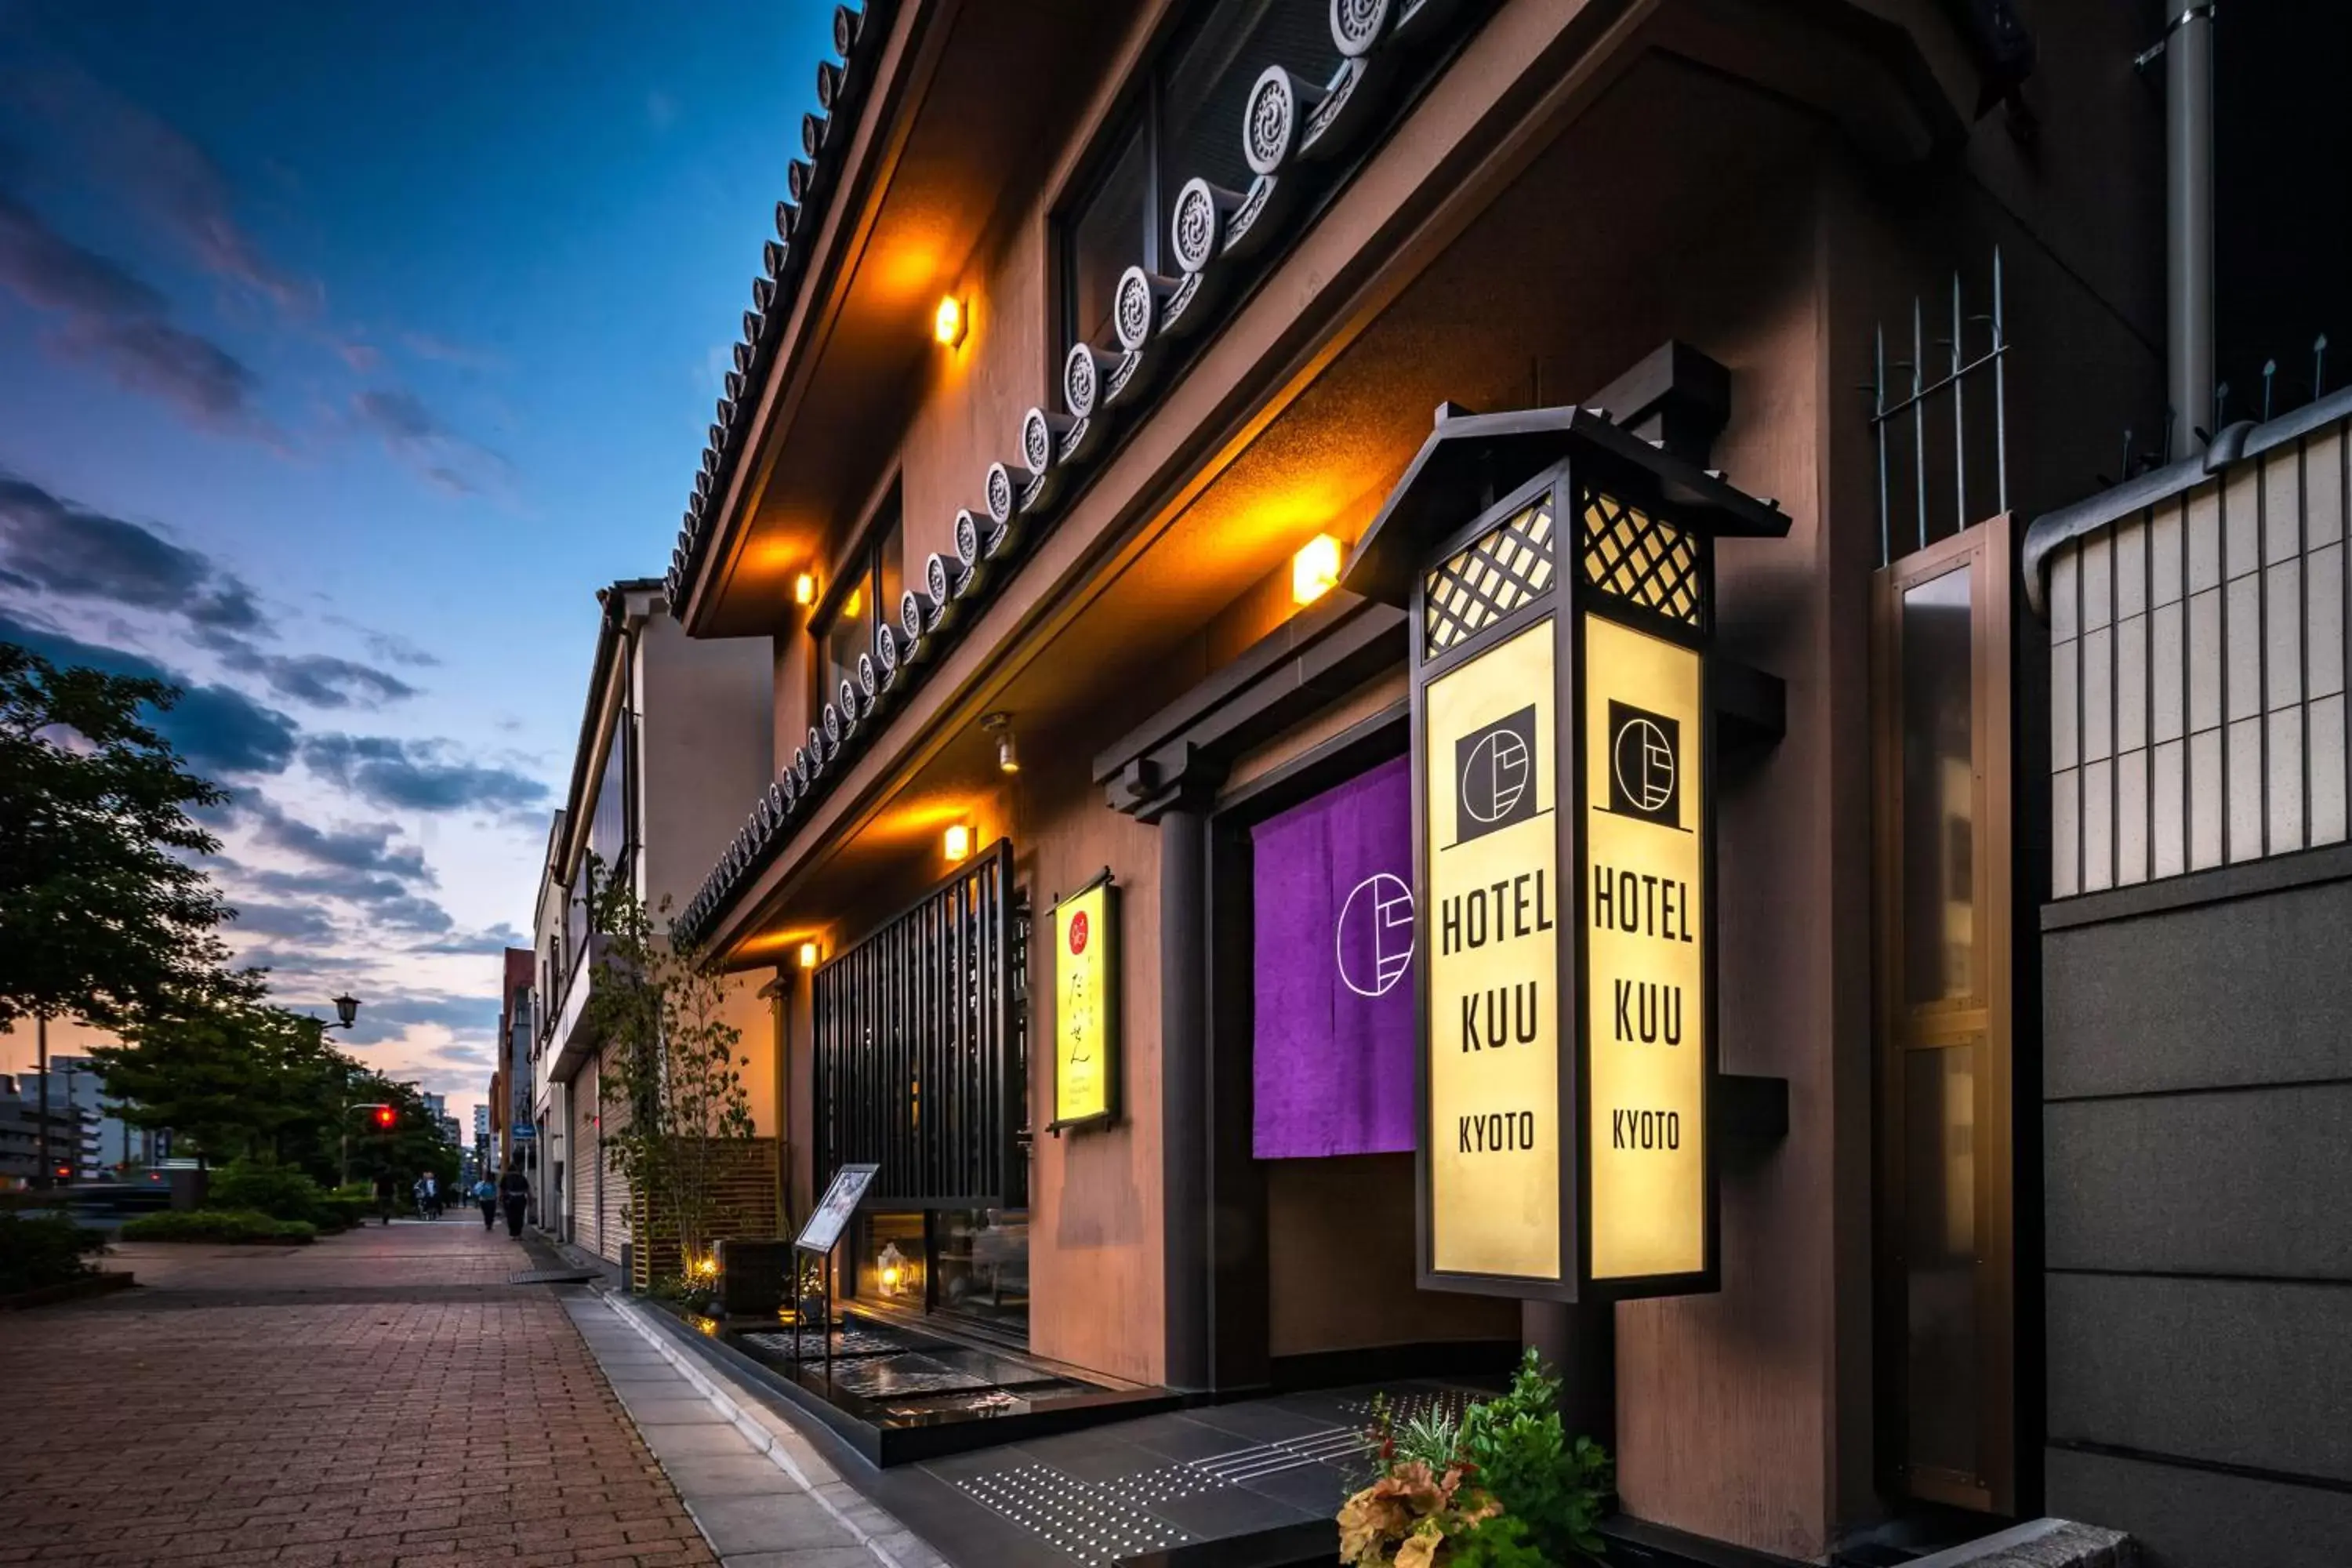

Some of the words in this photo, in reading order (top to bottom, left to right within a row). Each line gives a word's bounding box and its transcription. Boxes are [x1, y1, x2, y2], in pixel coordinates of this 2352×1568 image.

[1442, 869, 1553, 956] HOTEL
[1595, 865, 1693, 943] HOTEL
[1461, 981, 1537, 1053] KUU
[1614, 978, 1681, 1046] KUU
[1459, 1111, 1534, 1153] KYOTO
[1613, 1109, 1679, 1150] KYOTO
